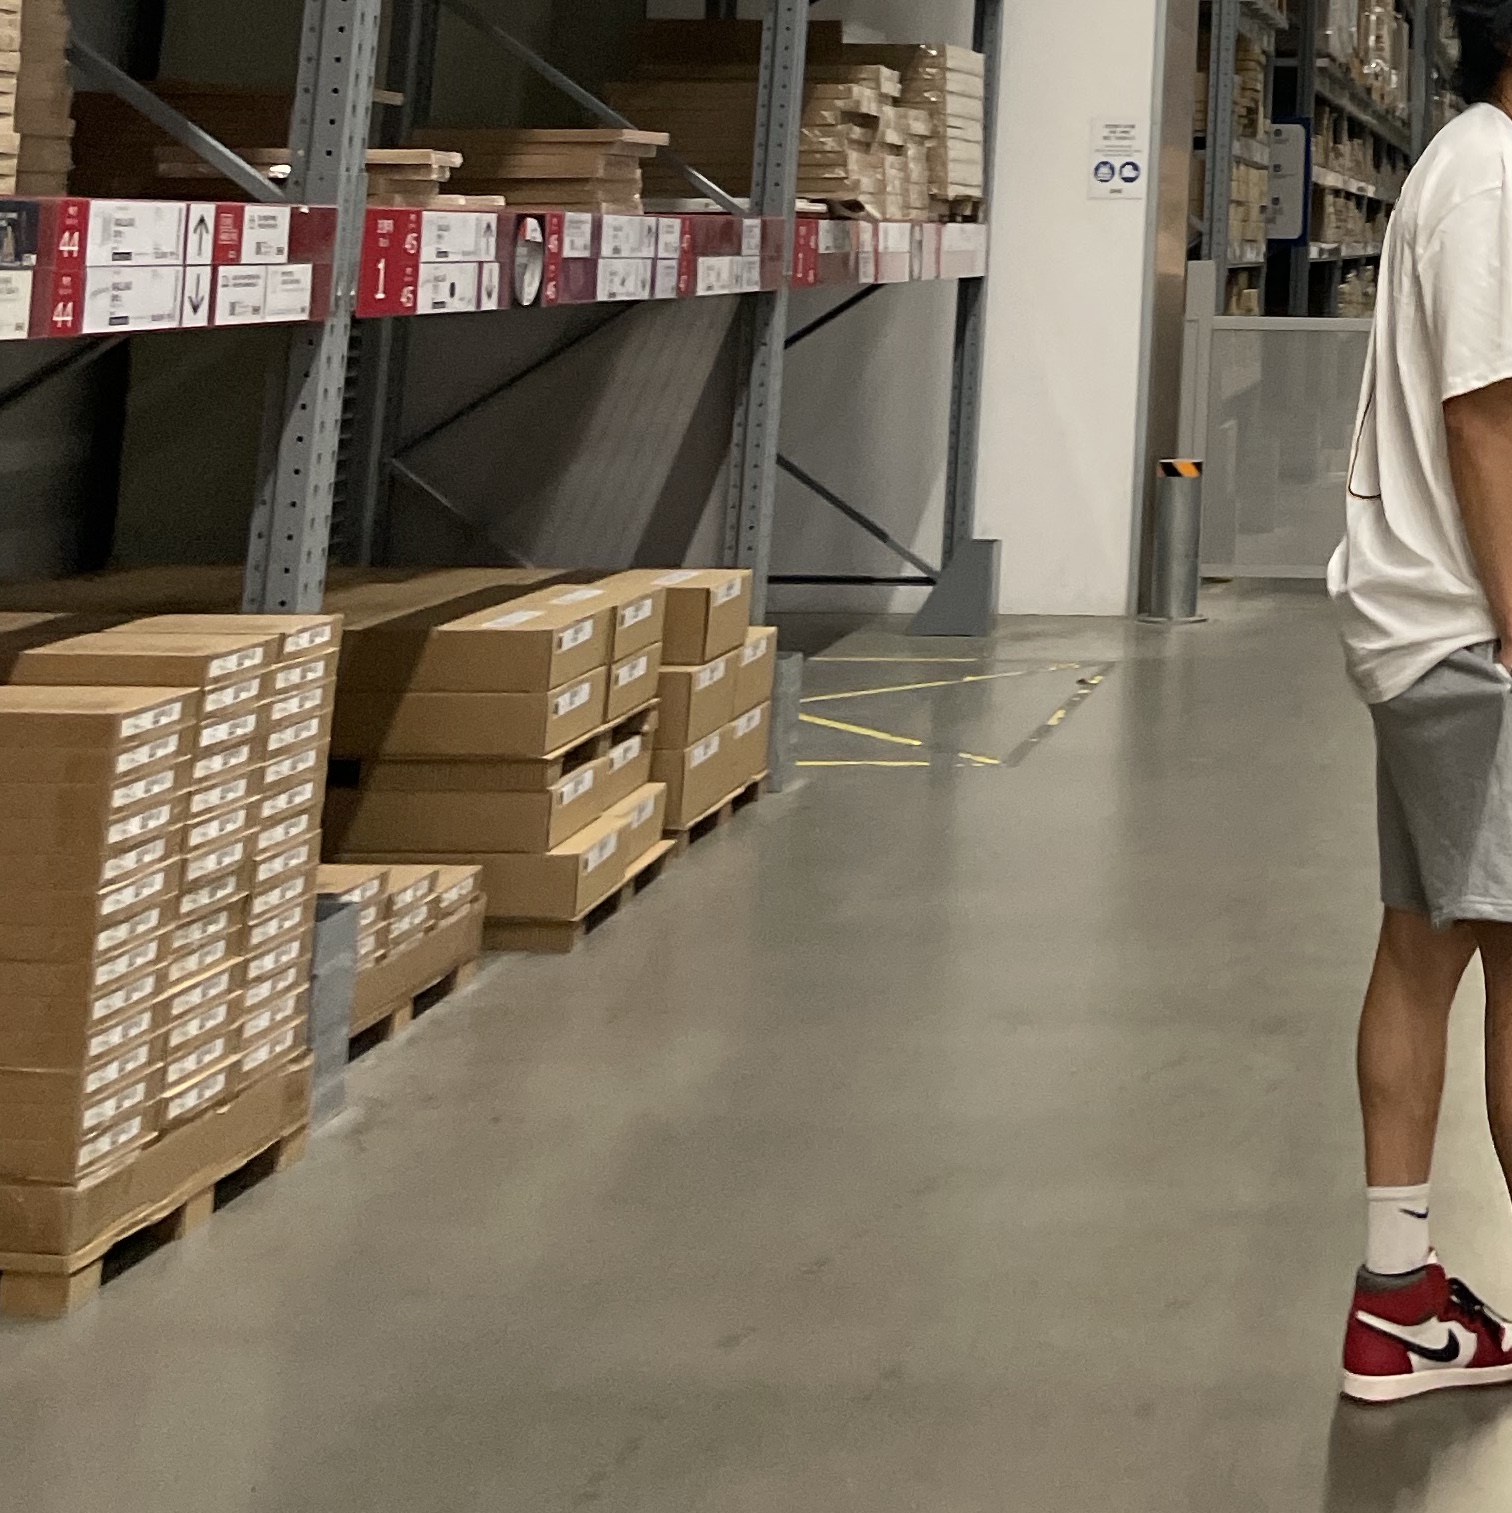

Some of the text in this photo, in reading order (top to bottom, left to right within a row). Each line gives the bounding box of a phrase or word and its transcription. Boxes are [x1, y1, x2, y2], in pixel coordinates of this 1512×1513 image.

[58, 230, 80, 258] 44
[374, 257, 386, 299] 1
[52, 301, 74, 328] 44
